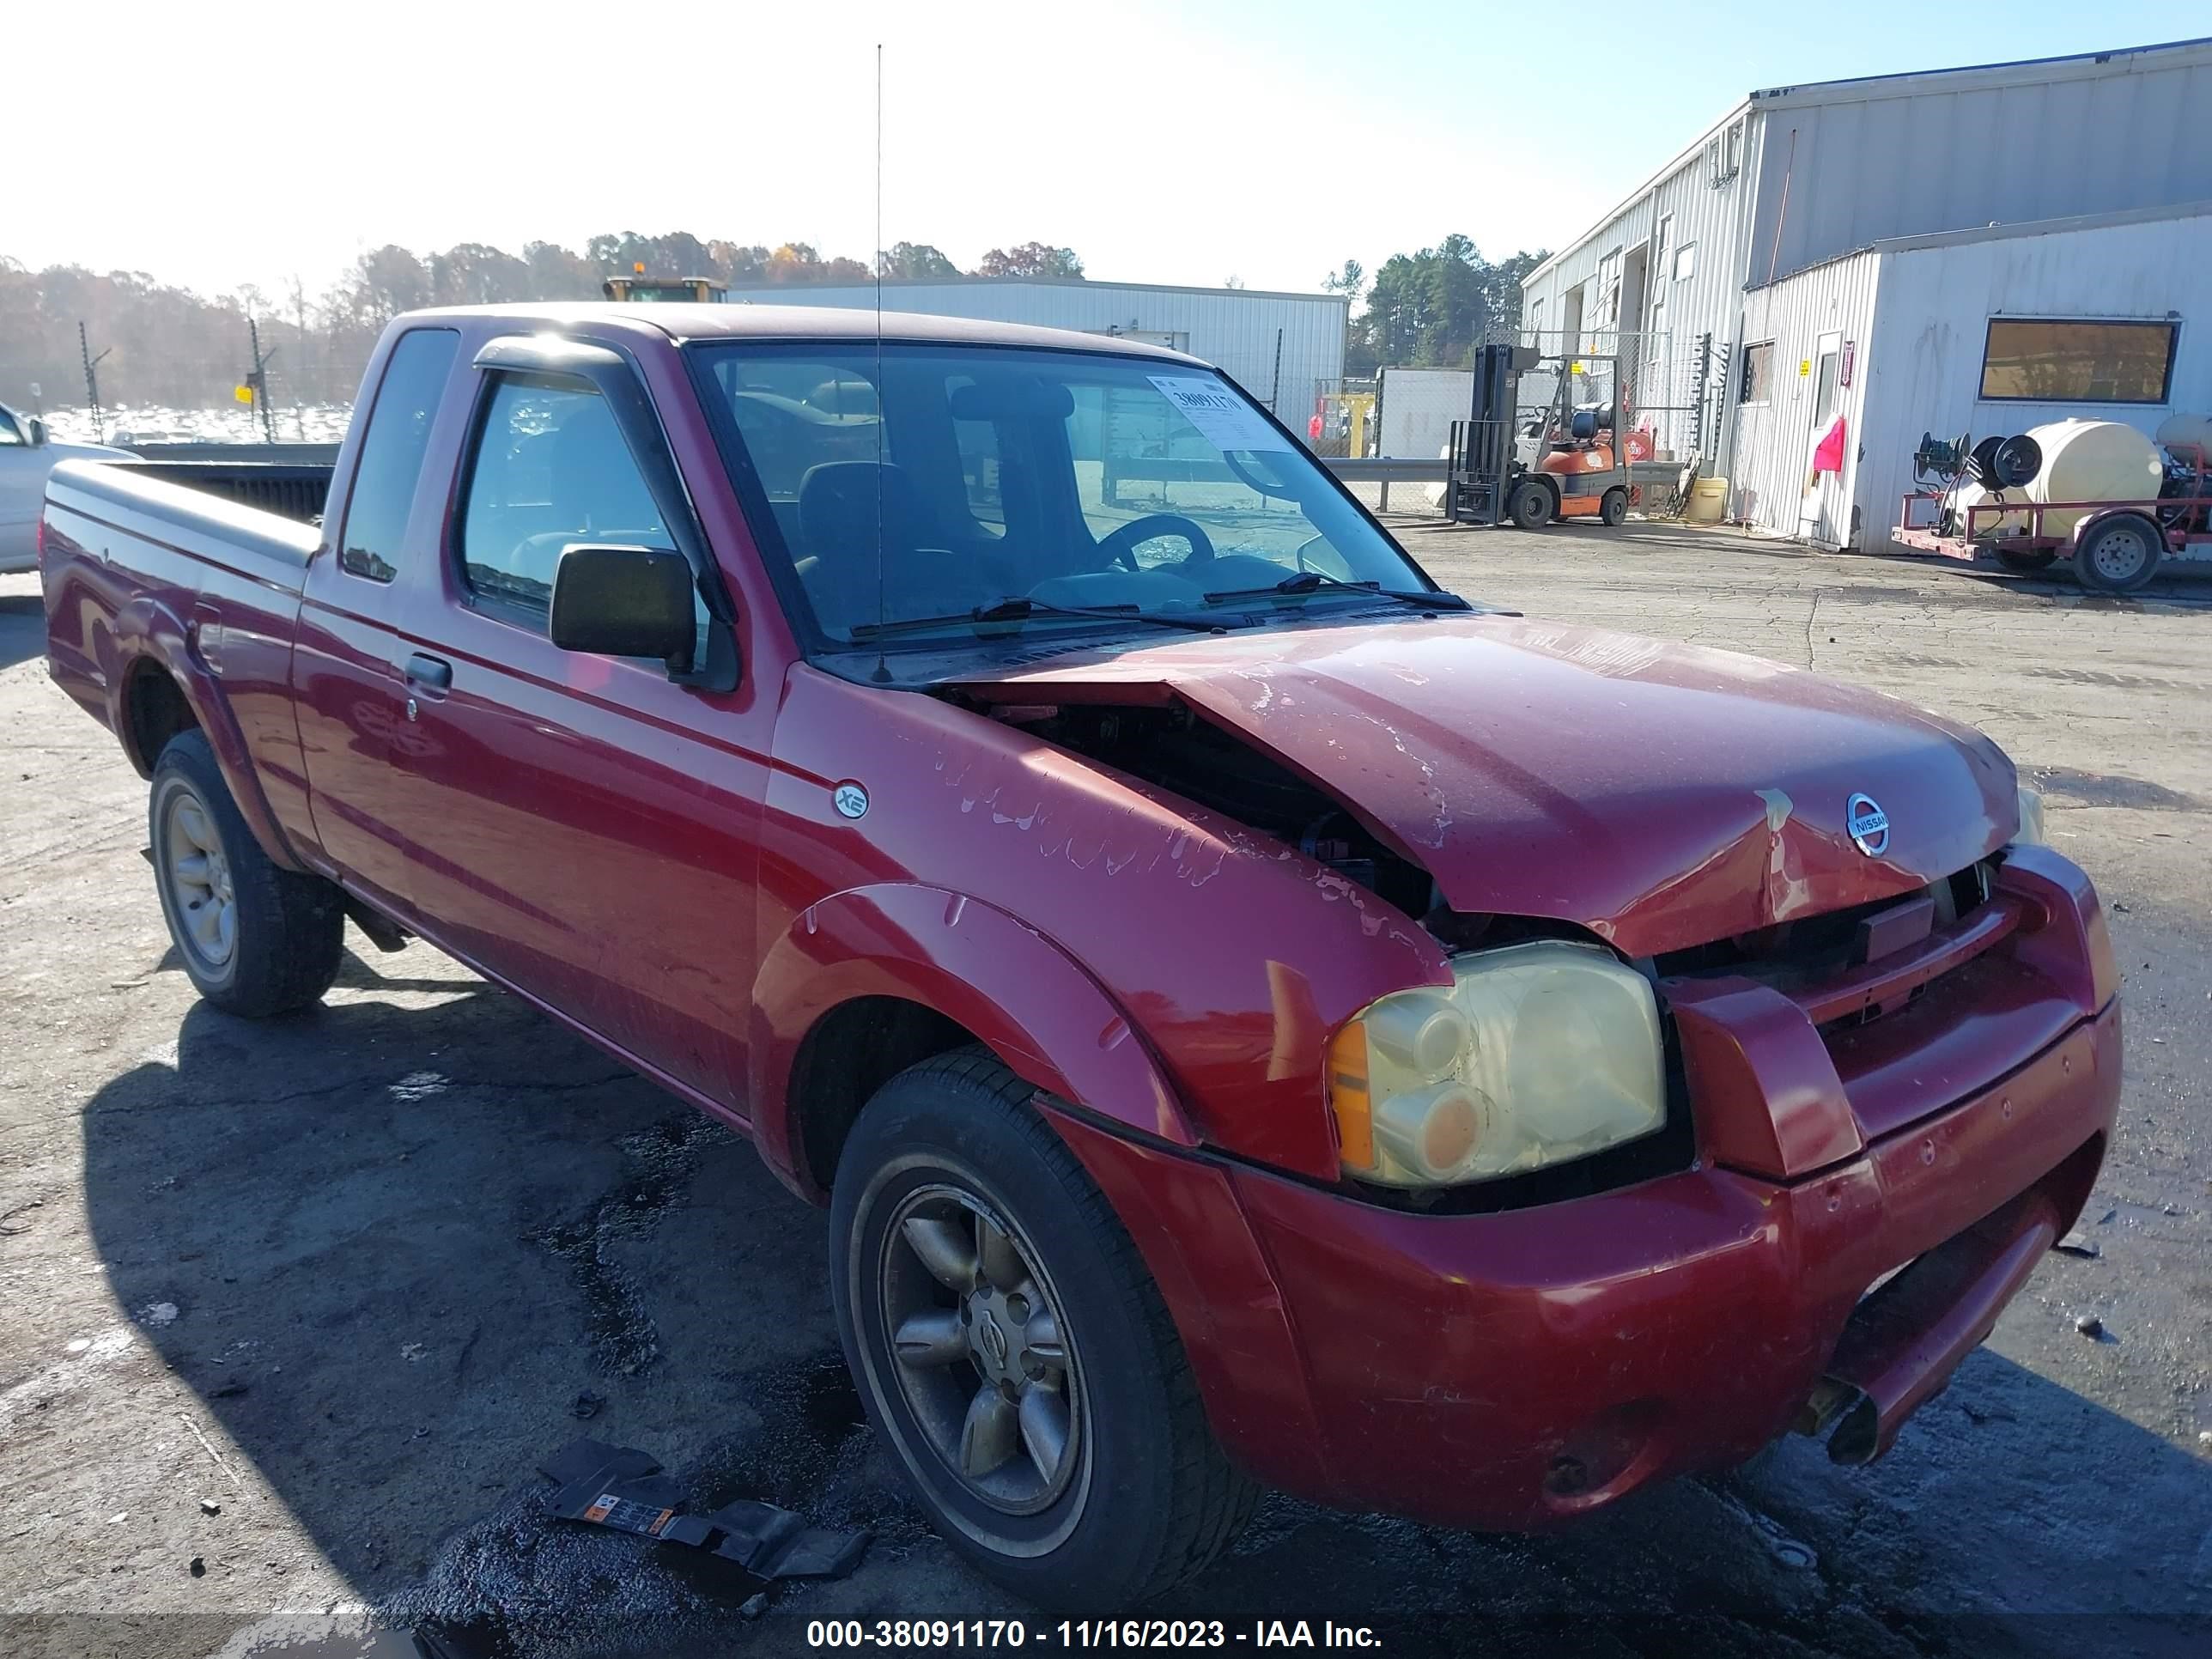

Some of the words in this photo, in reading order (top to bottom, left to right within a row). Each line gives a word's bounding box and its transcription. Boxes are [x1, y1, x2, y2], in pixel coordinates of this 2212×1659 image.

[1173, 392, 1243, 411] 38091170
[837, 788, 866, 814] XE
[1856, 816, 1888, 833] NISSAN
